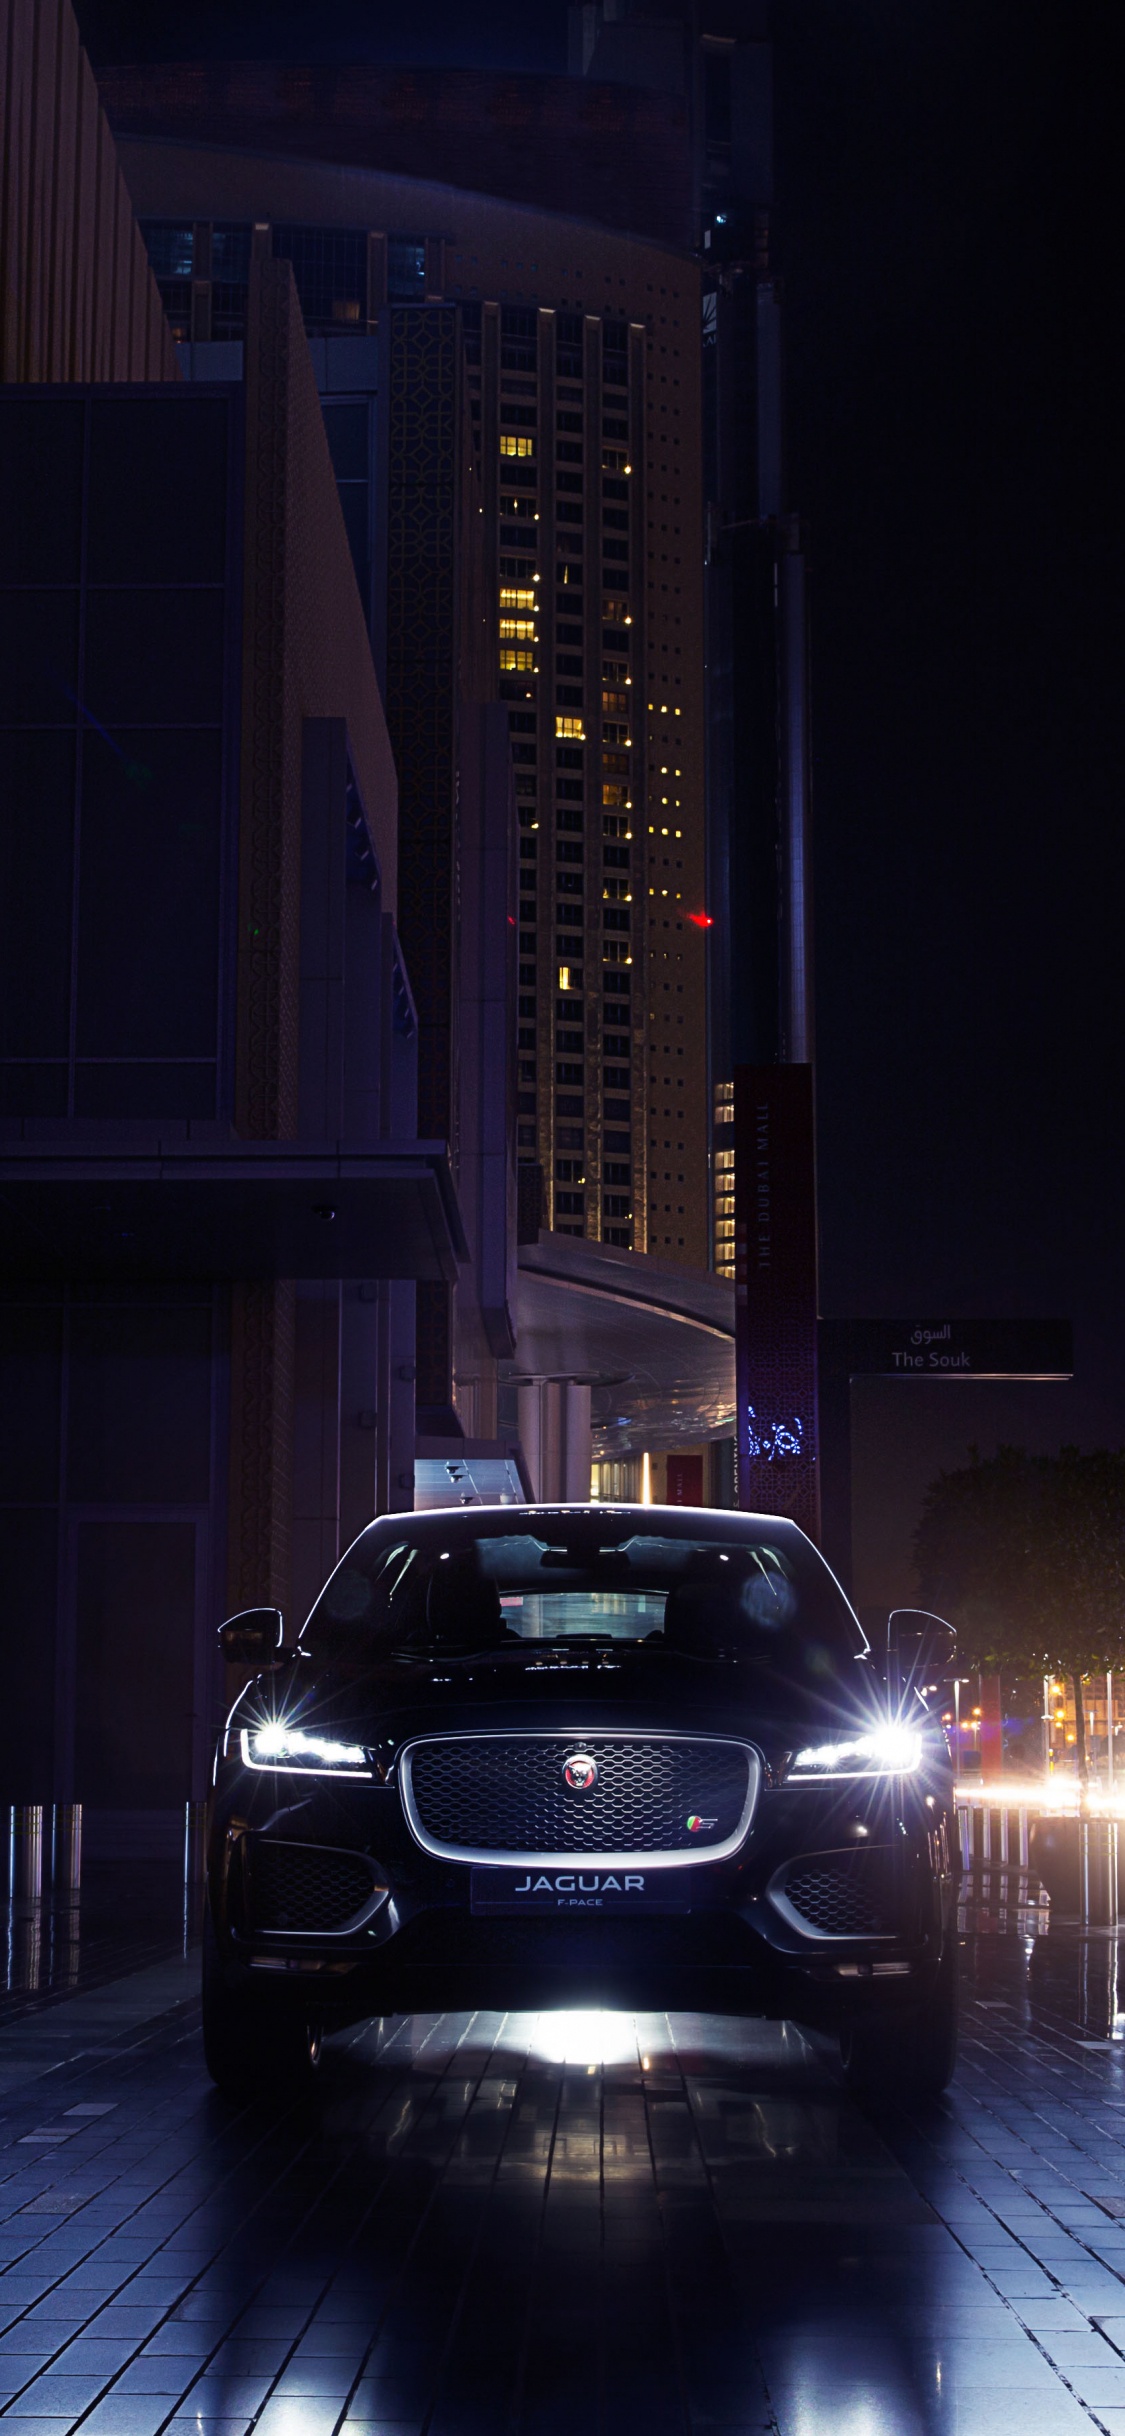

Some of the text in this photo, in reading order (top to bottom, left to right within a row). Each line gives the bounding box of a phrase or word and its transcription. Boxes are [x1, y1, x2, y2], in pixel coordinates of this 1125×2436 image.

[755, 1102, 771, 1269] THE DUBAI MALL
[910, 1324, 951, 1345] السوق
[891, 1351, 971, 1367] The Souk
[514, 1875, 645, 1892] JAGUAR
[557, 1898, 604, 1907] F-PACE
